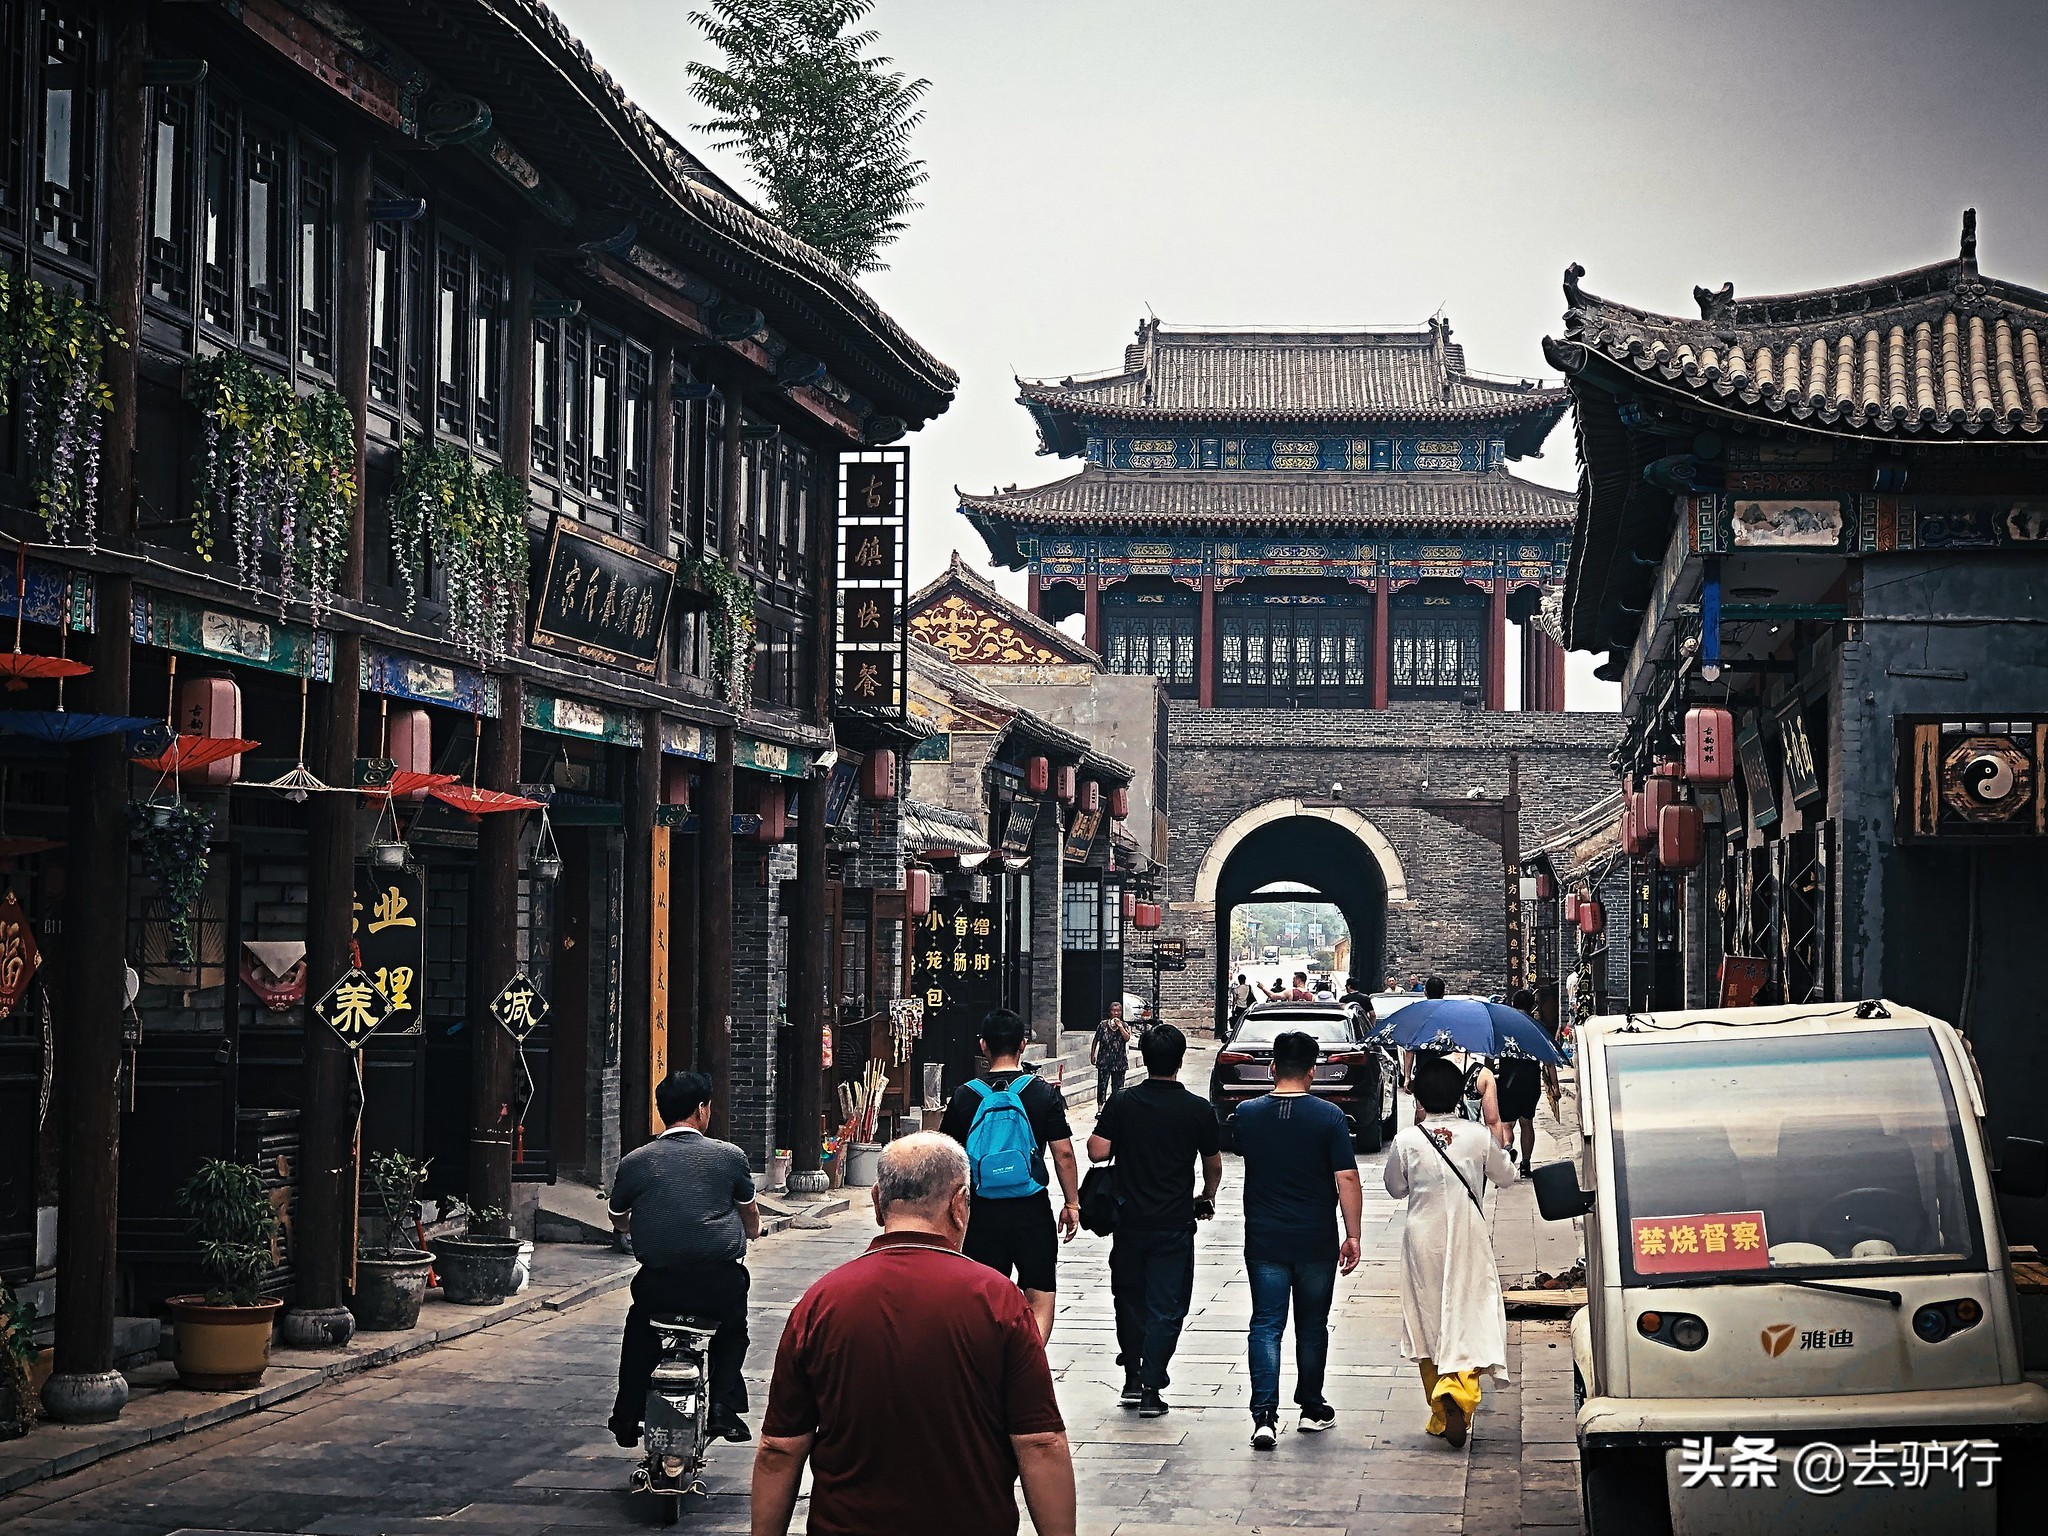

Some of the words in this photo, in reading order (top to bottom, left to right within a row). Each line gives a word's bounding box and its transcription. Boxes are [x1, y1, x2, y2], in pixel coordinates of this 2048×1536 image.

[925, 910, 944, 1007] 小笼包
[953, 916, 967, 972] 香肠
[331, 982, 380, 1033] 养
[503, 987, 537, 1028] 减
[1638, 1221, 1761, 1256] 禁烧督察
[1800, 1328, 1855, 1351] 雅迪
